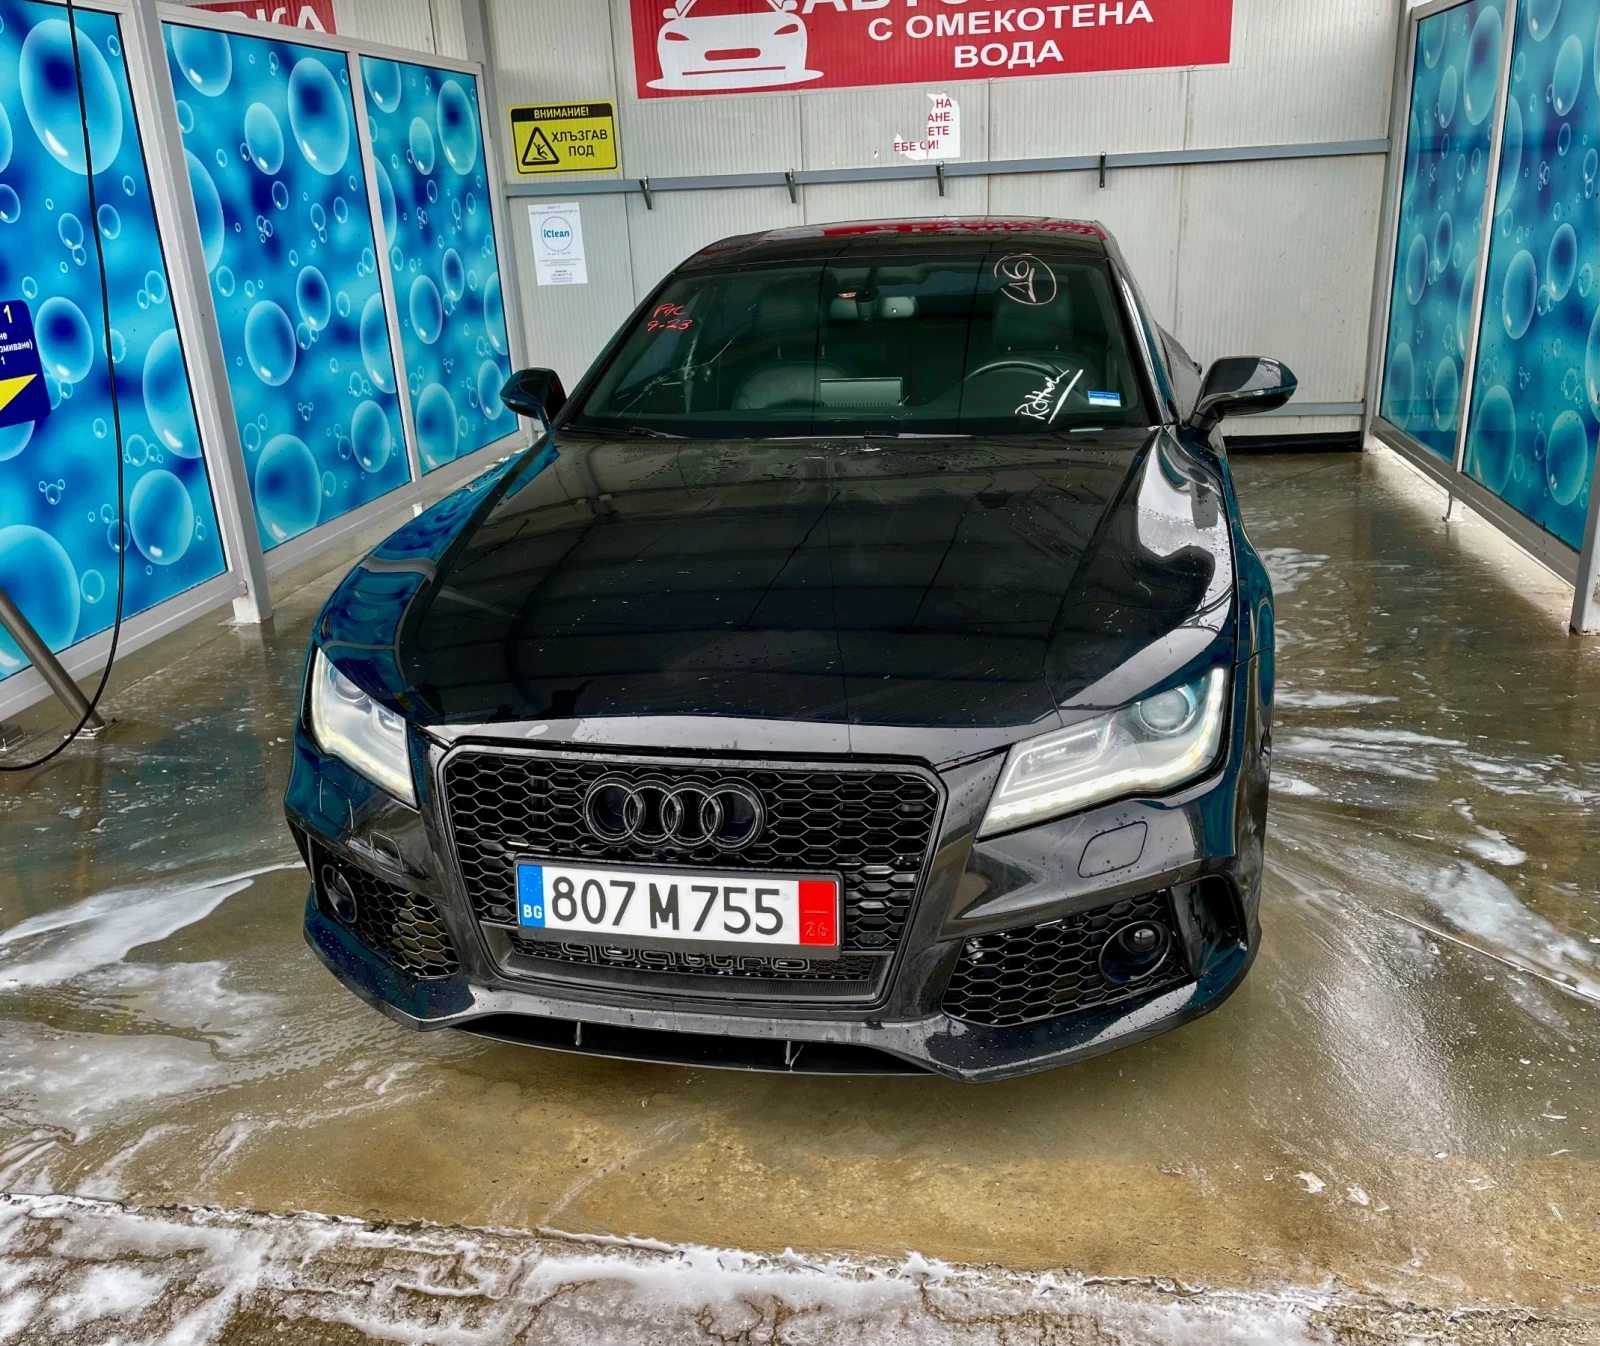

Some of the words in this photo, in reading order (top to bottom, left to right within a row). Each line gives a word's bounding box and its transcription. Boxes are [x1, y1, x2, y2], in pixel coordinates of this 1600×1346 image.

[868, 18, 893, 41] С
[906, 1, 1154, 39] ОМЕКОТЕНА
[954, 40, 1064, 68] ВОДА
[936, 98, 952, 109] НА
[533, 106, 590, 119] ВНИМАНИЕ!
[551, 129, 608, 142] ХЛЪЗГАВ
[568, 145, 595, 157] ПОД
[543, 229, 570, 238] iClean
[3, 304, 12, 323] 1
[523, 905, 543, 919] BG
[551, 876, 636, 926] 807
[691, 885, 783, 935] 755
